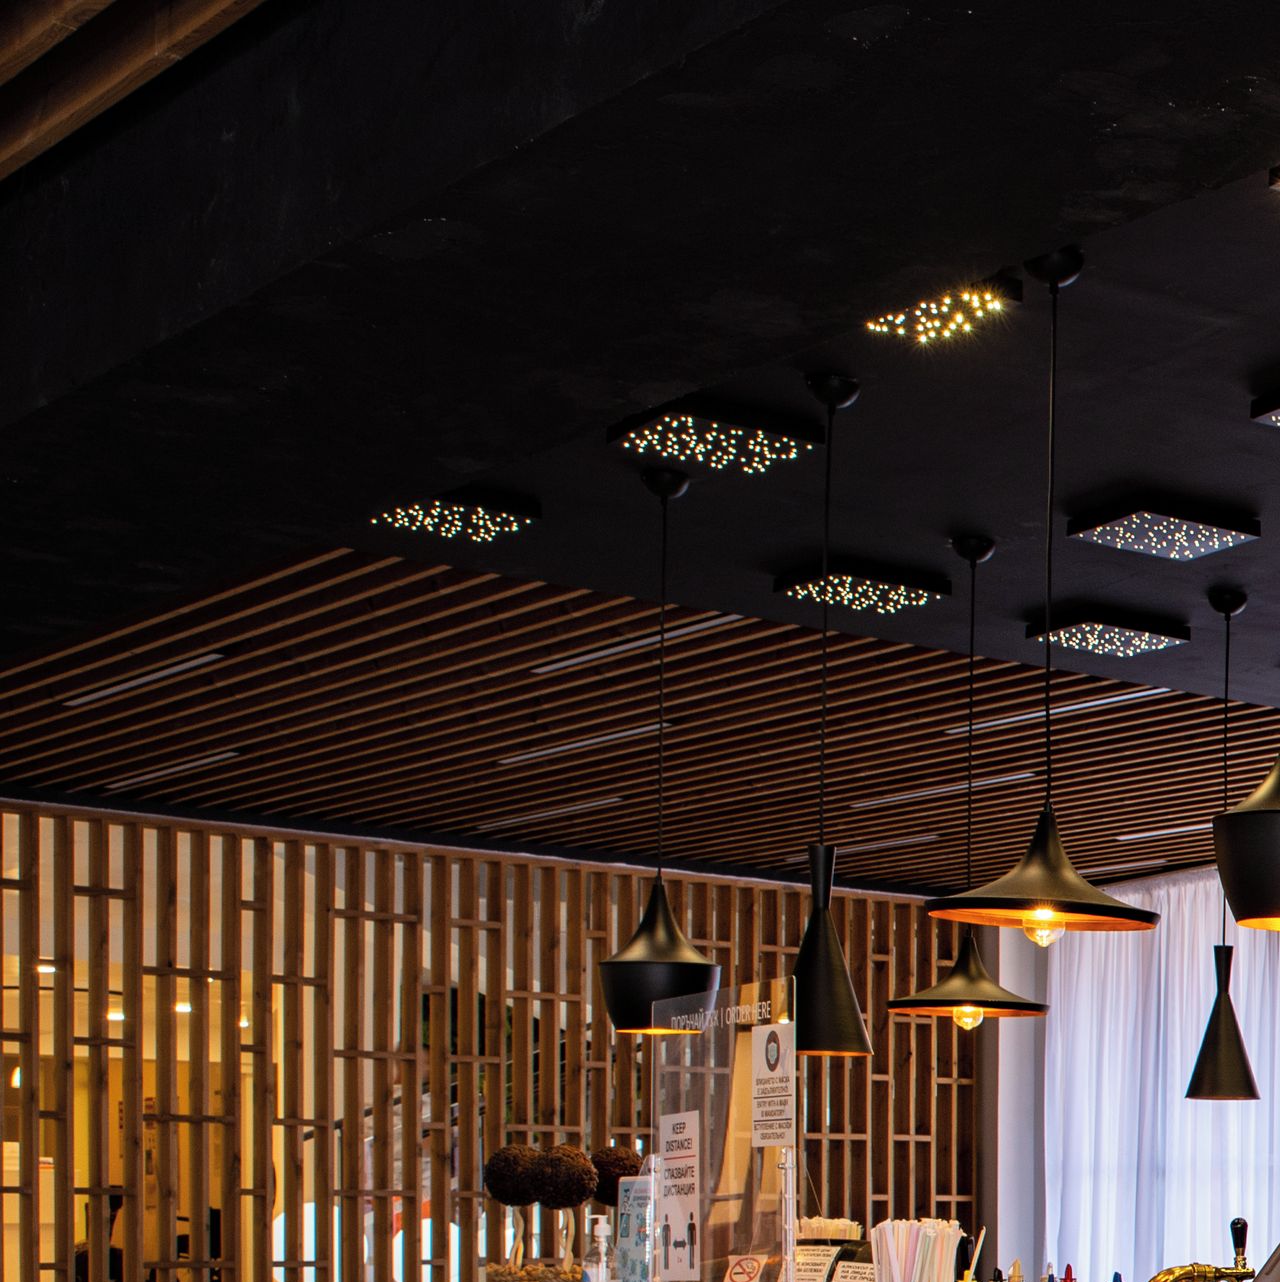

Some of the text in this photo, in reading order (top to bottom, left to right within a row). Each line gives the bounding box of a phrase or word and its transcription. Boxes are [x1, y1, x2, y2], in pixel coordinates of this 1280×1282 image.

[725, 1000, 771, 1025] ORDER HERE
[671, 1122, 687, 1134] KEEP
[666, 1138, 692, 1153] DISTANCE!
[664, 1165, 695, 1181] СПАЗВАЙТЕ
[663, 1183, 696, 1198] ДИСТАНЦИЯ
